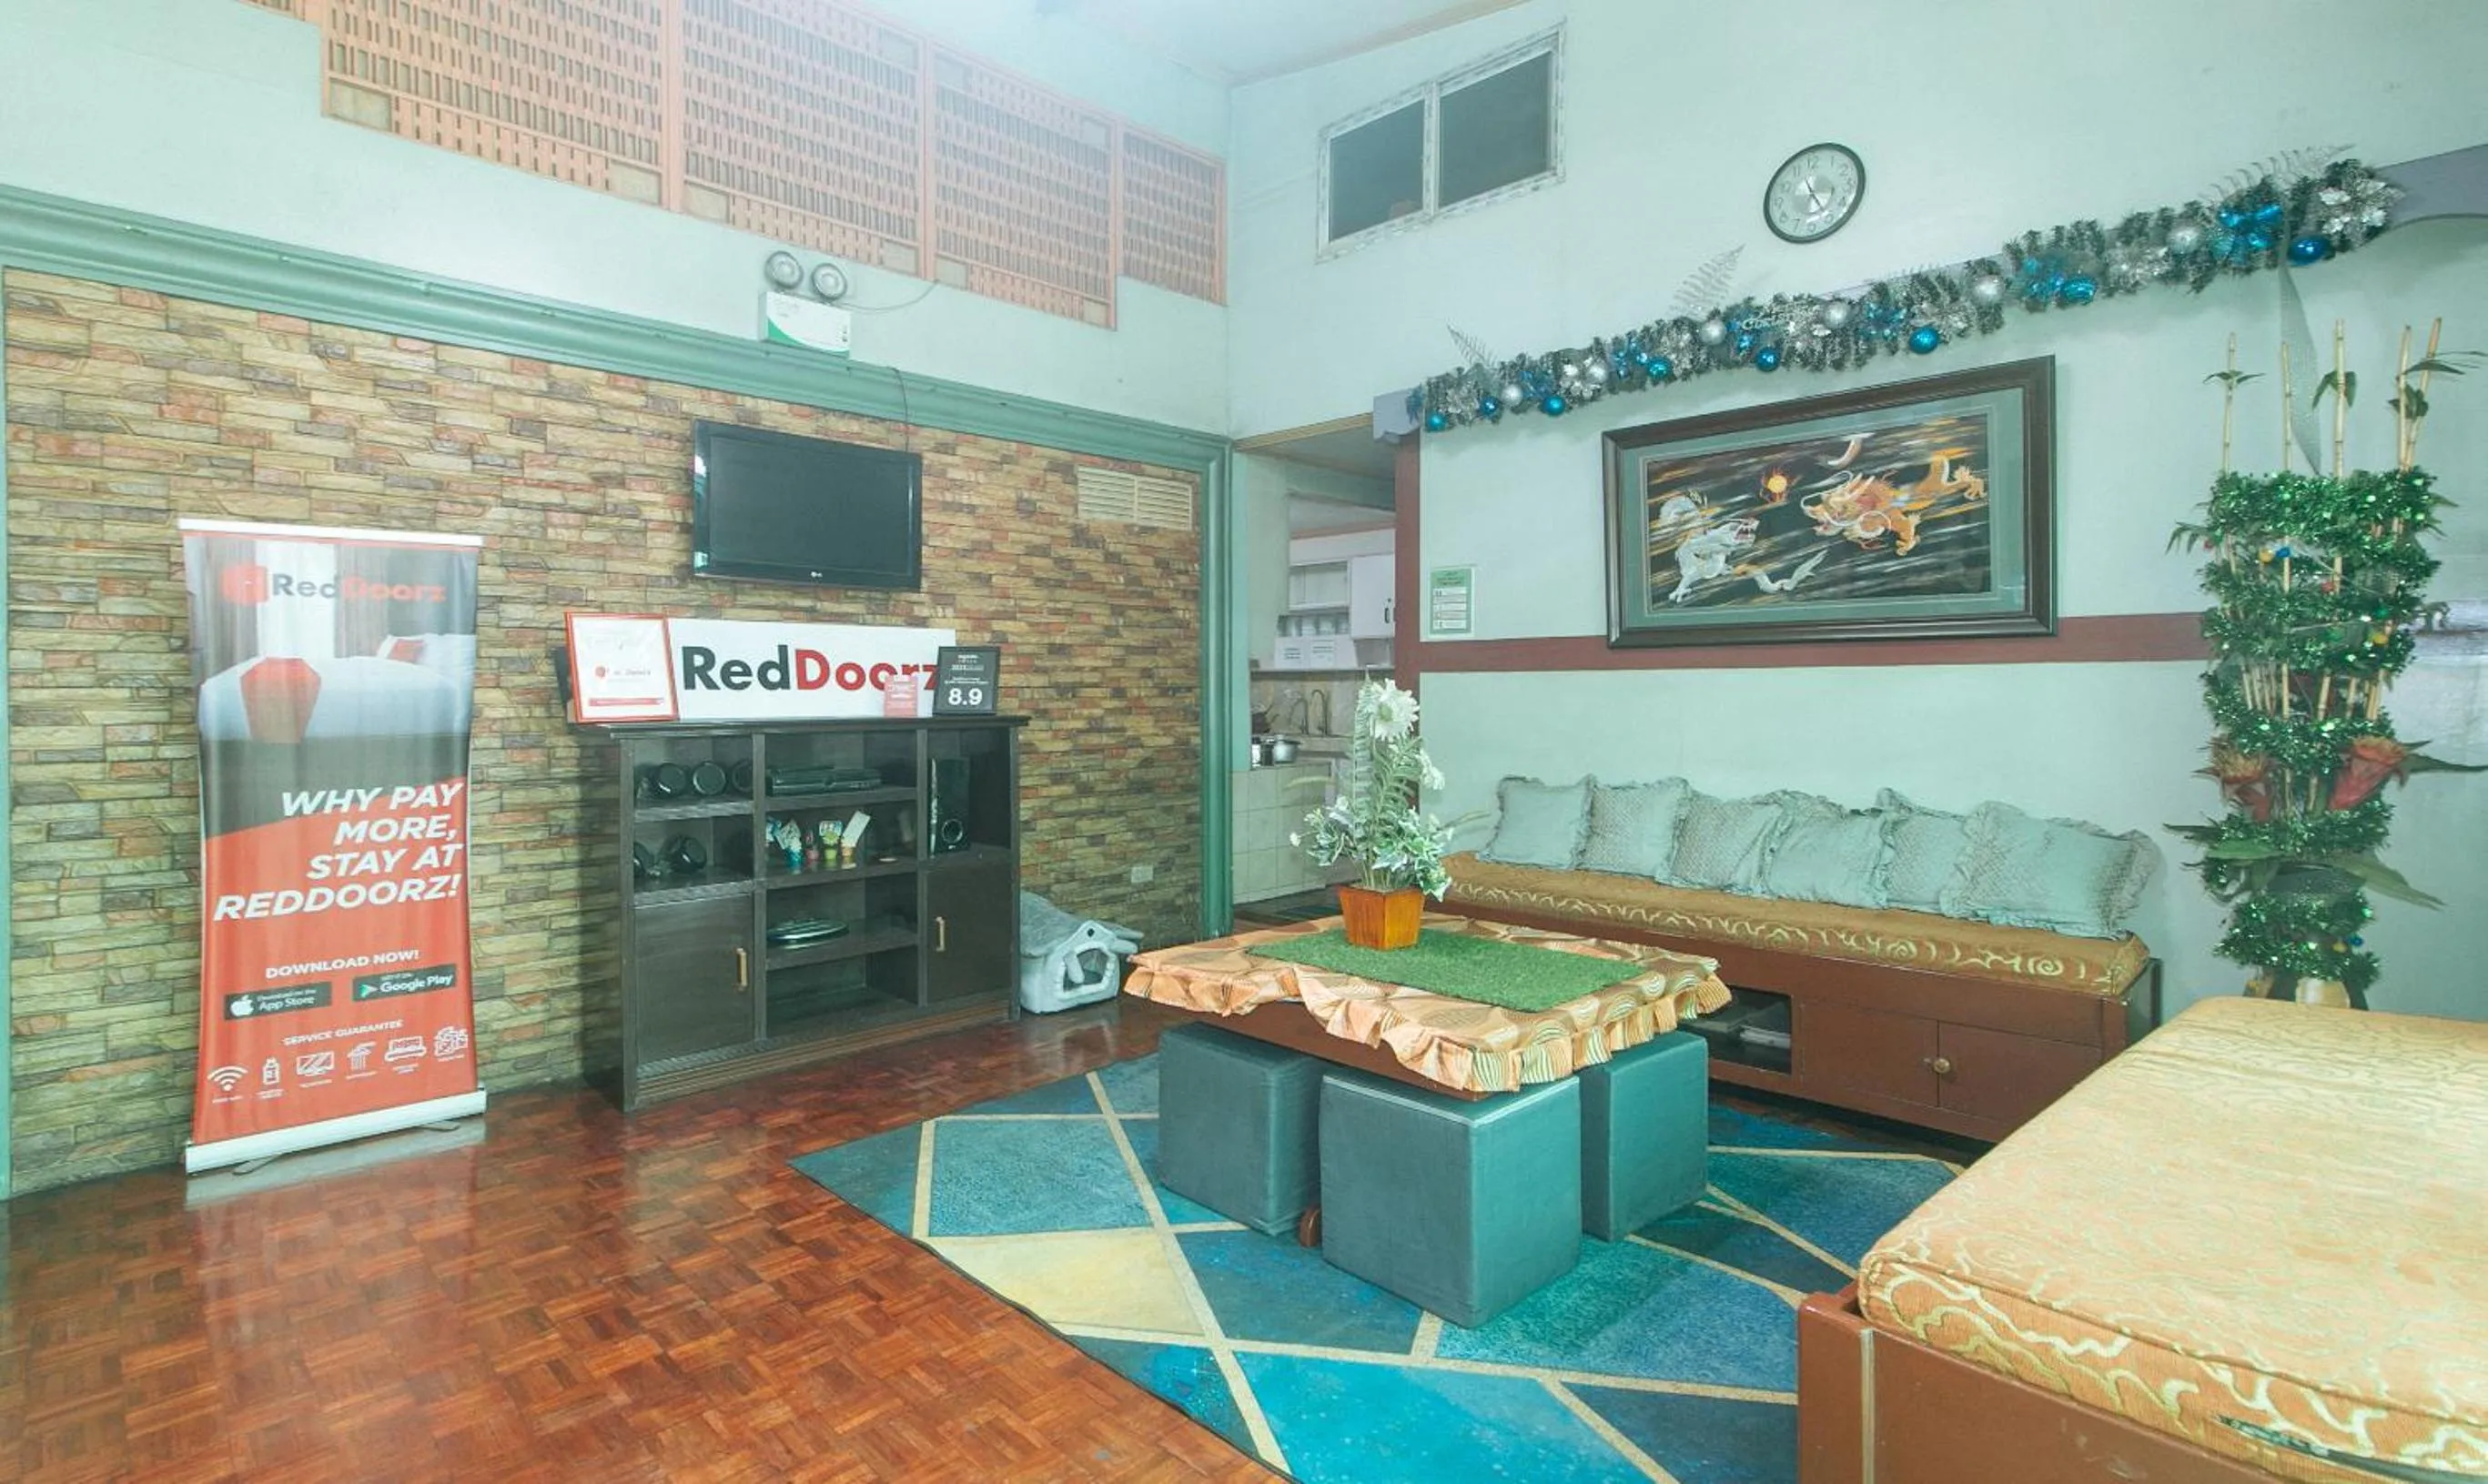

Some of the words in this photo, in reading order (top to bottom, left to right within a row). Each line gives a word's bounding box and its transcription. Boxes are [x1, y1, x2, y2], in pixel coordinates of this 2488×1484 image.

[948, 688, 983, 705] 8.9
[282, 787, 383, 816] WHY
[389, 782, 463, 810] PAY
[333, 814, 456, 846] MORE,
[306, 848, 408, 880] STAY
[411, 843, 464, 871] AT
[213, 873, 462, 922] REDDOORZ!
[265, 956, 369, 979] DOWNLOAD
[372, 950, 420, 964] NOW!
[379, 978, 426, 993] Google
[427, 974, 453, 986] Play
[258, 1001, 284, 1012] App
[285, 997, 315, 1008] Store
